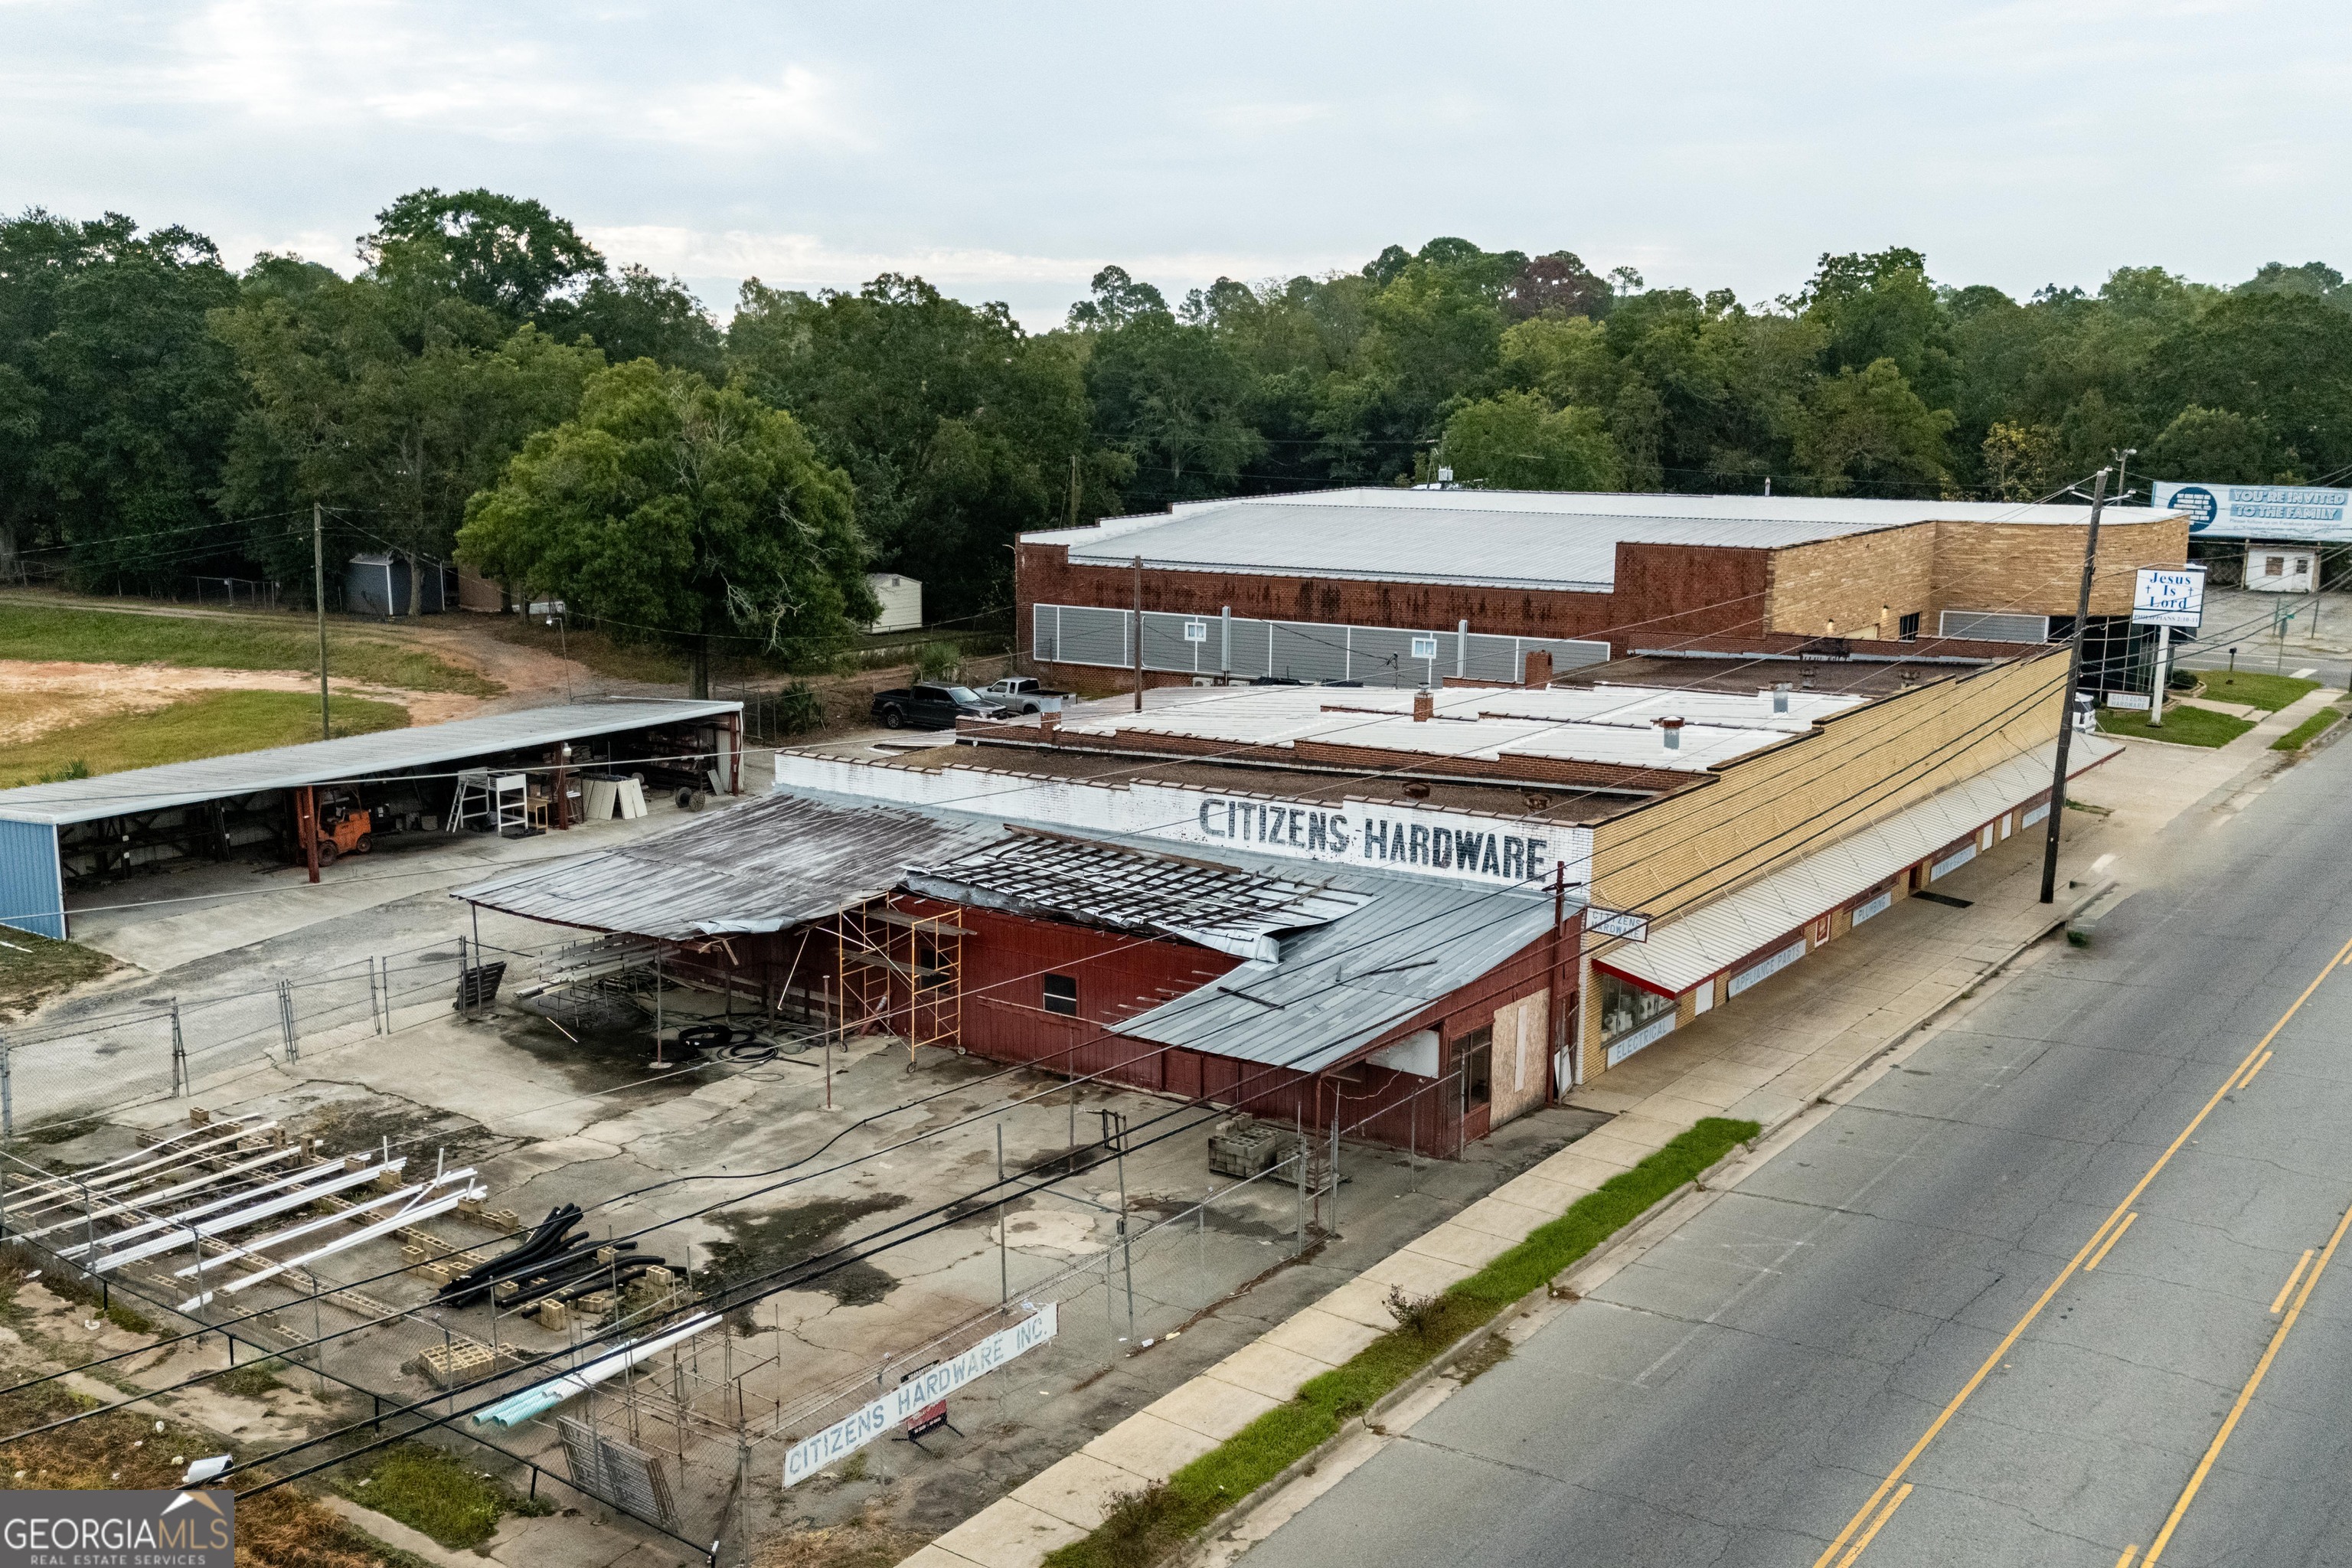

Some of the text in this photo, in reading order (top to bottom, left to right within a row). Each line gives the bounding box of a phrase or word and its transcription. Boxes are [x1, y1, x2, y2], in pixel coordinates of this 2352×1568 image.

[2233, 490, 2345, 505] YOU'RE INVITED
[2236, 505, 2337, 520] TO THE FAMILY
[2150, 572, 2191, 585] Jesus
[2163, 584, 2177, 596] Is
[2150, 596, 2187, 609] Lord
[2111, 701, 2146, 709] HARDWARE
[2112, 694, 2147, 703] CITIZENS
[1199, 799, 1548, 883] CITIZENS HARDWARE
[1858, 895, 1886, 923] PLUMBING
[1735, 944, 1801, 993] APPLIANCE PARTS
[1616, 1020, 1668, 1060] ELECTRICAL
[789, 1317, 1047, 1475] CITIZENS HARDWARE INC.
